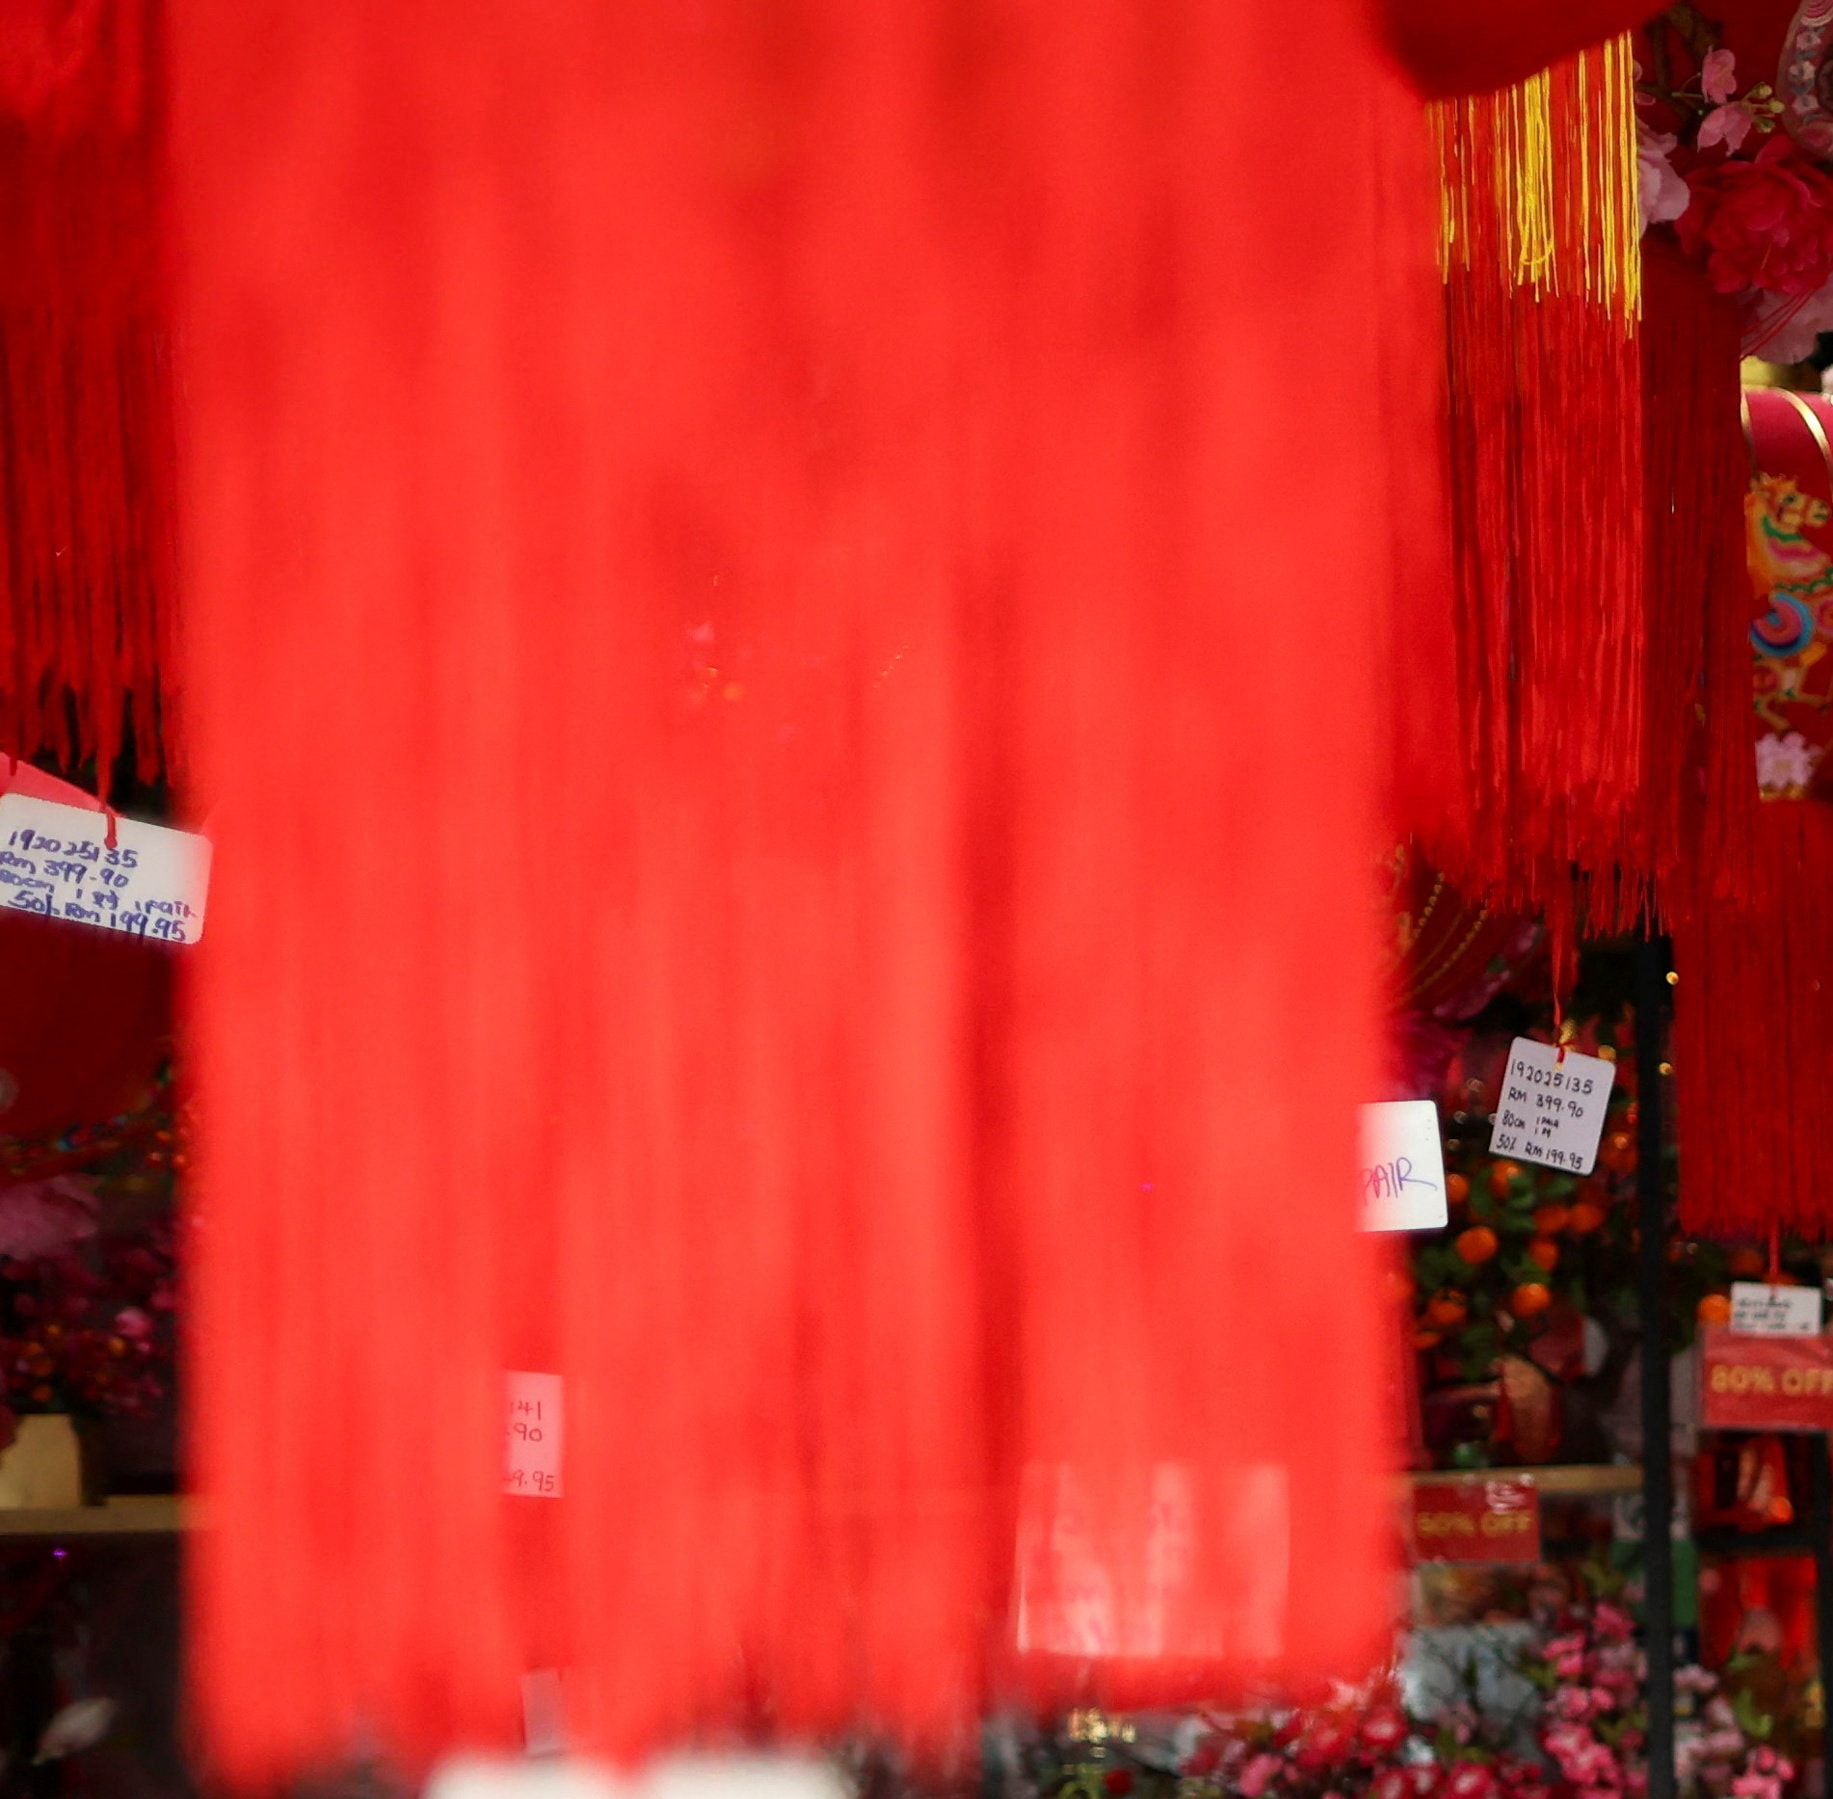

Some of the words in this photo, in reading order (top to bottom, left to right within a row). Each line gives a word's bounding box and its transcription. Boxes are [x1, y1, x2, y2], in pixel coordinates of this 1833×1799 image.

[1510, 1059, 1594, 1095] 192025135
[1507, 1086, 1527, 1103] RM
[1524, 1141, 1543, 1157] RM
